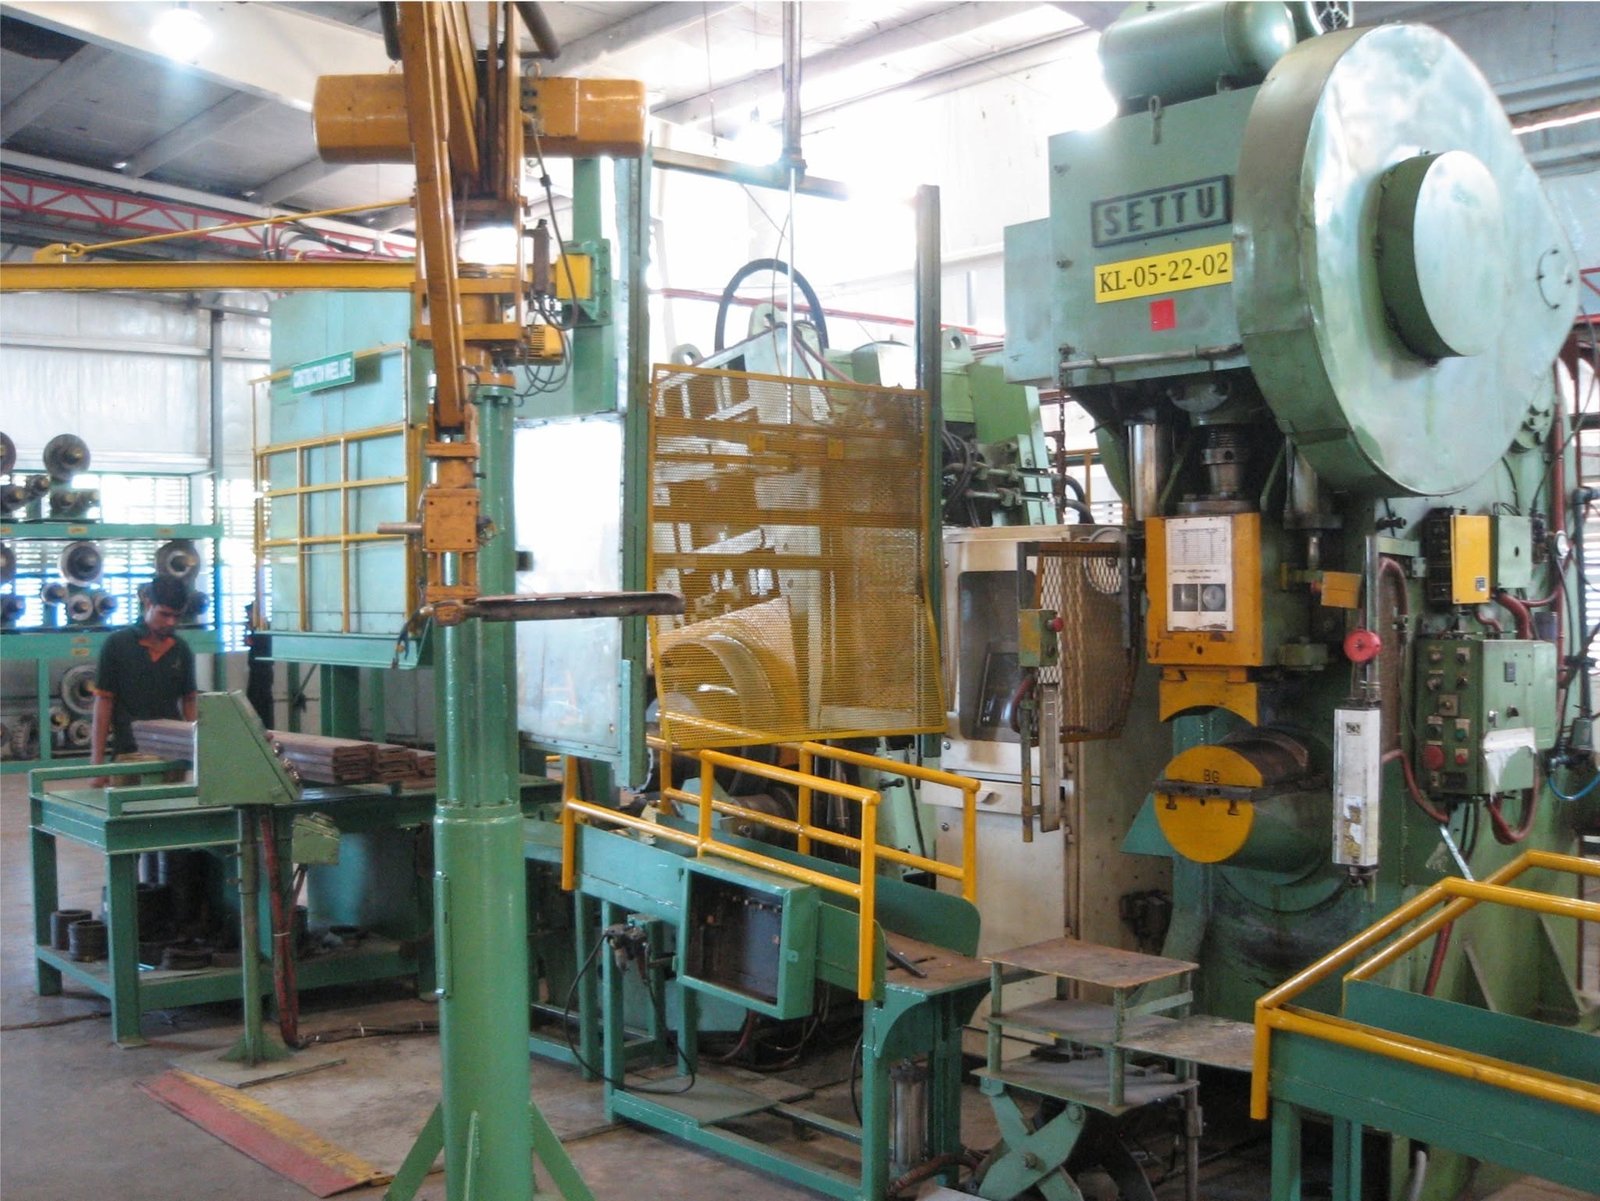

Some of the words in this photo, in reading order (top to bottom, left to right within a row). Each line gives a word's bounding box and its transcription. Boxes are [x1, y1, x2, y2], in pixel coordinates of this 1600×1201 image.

[1104, 186, 1216, 236] SETTU
[1099, 252, 1229, 294] KL-05-22-02
[1203, 769, 1220, 783] BG
